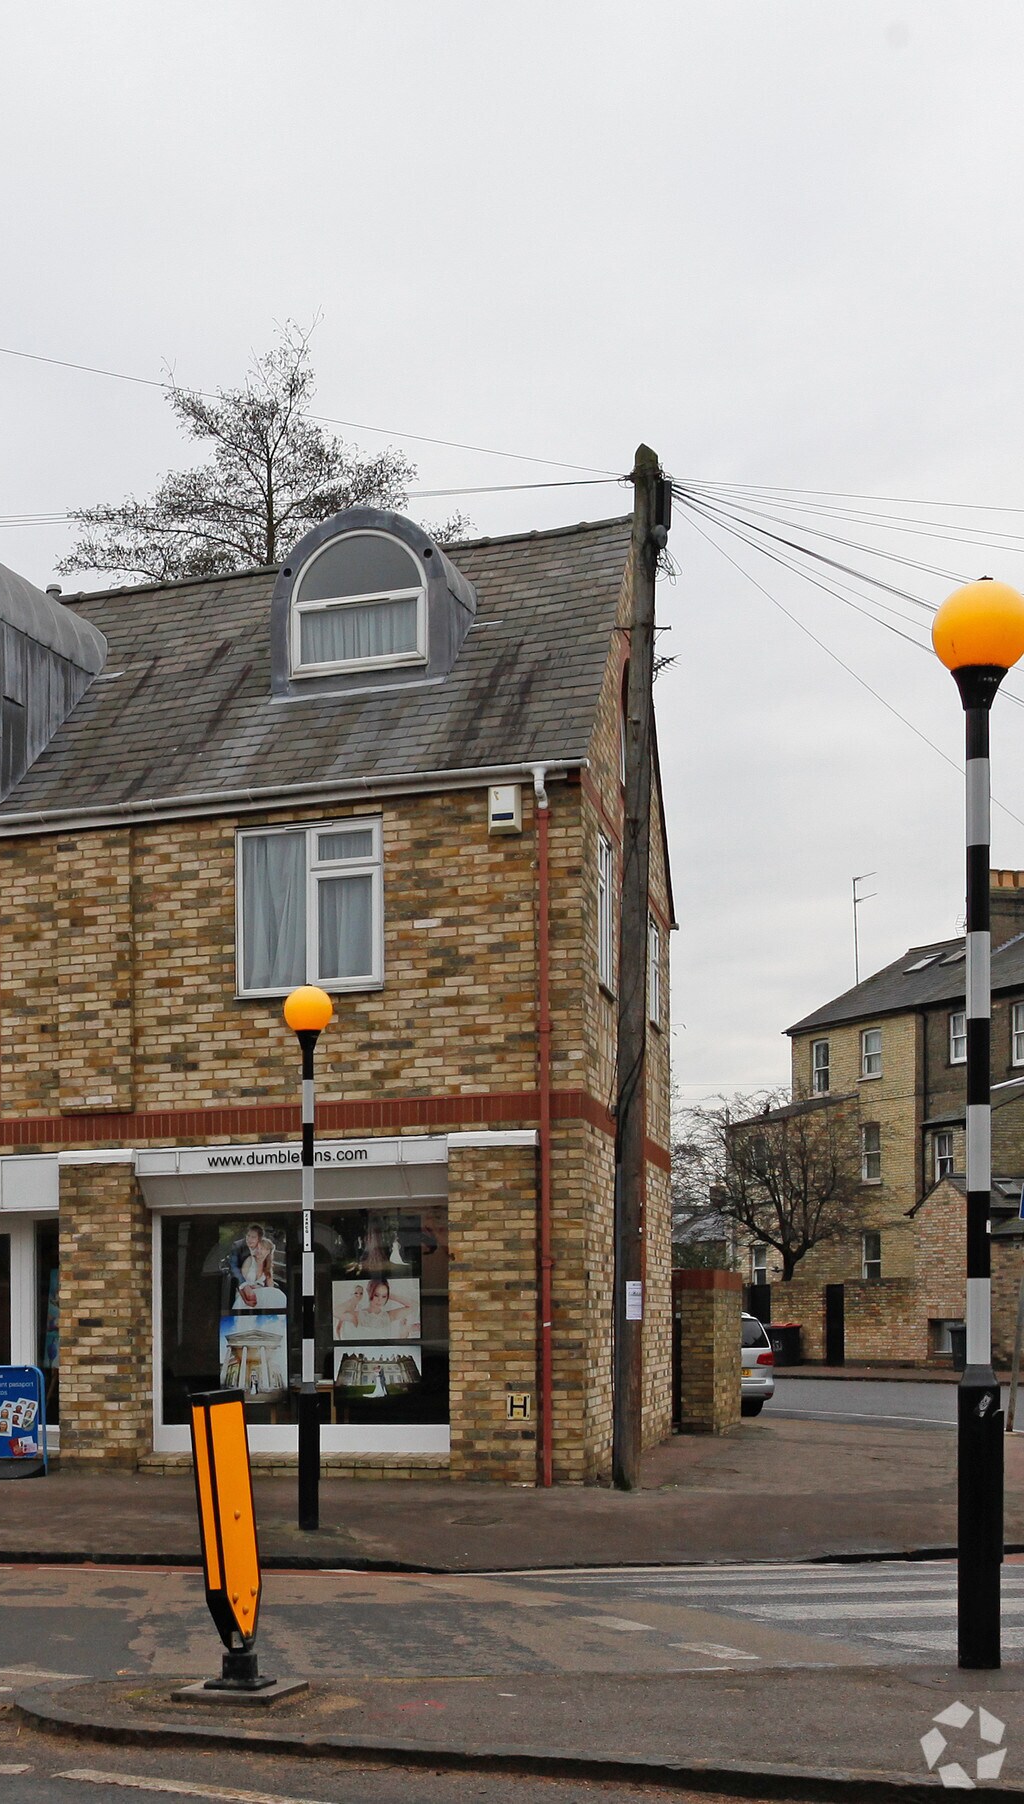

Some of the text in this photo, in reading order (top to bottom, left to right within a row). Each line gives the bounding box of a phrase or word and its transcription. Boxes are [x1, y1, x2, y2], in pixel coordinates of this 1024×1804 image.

[207, 1149, 368, 1167] www.dumblens.com
[8, 1381, 34, 1389] passport
[510, 1396, 526, 1417] H
